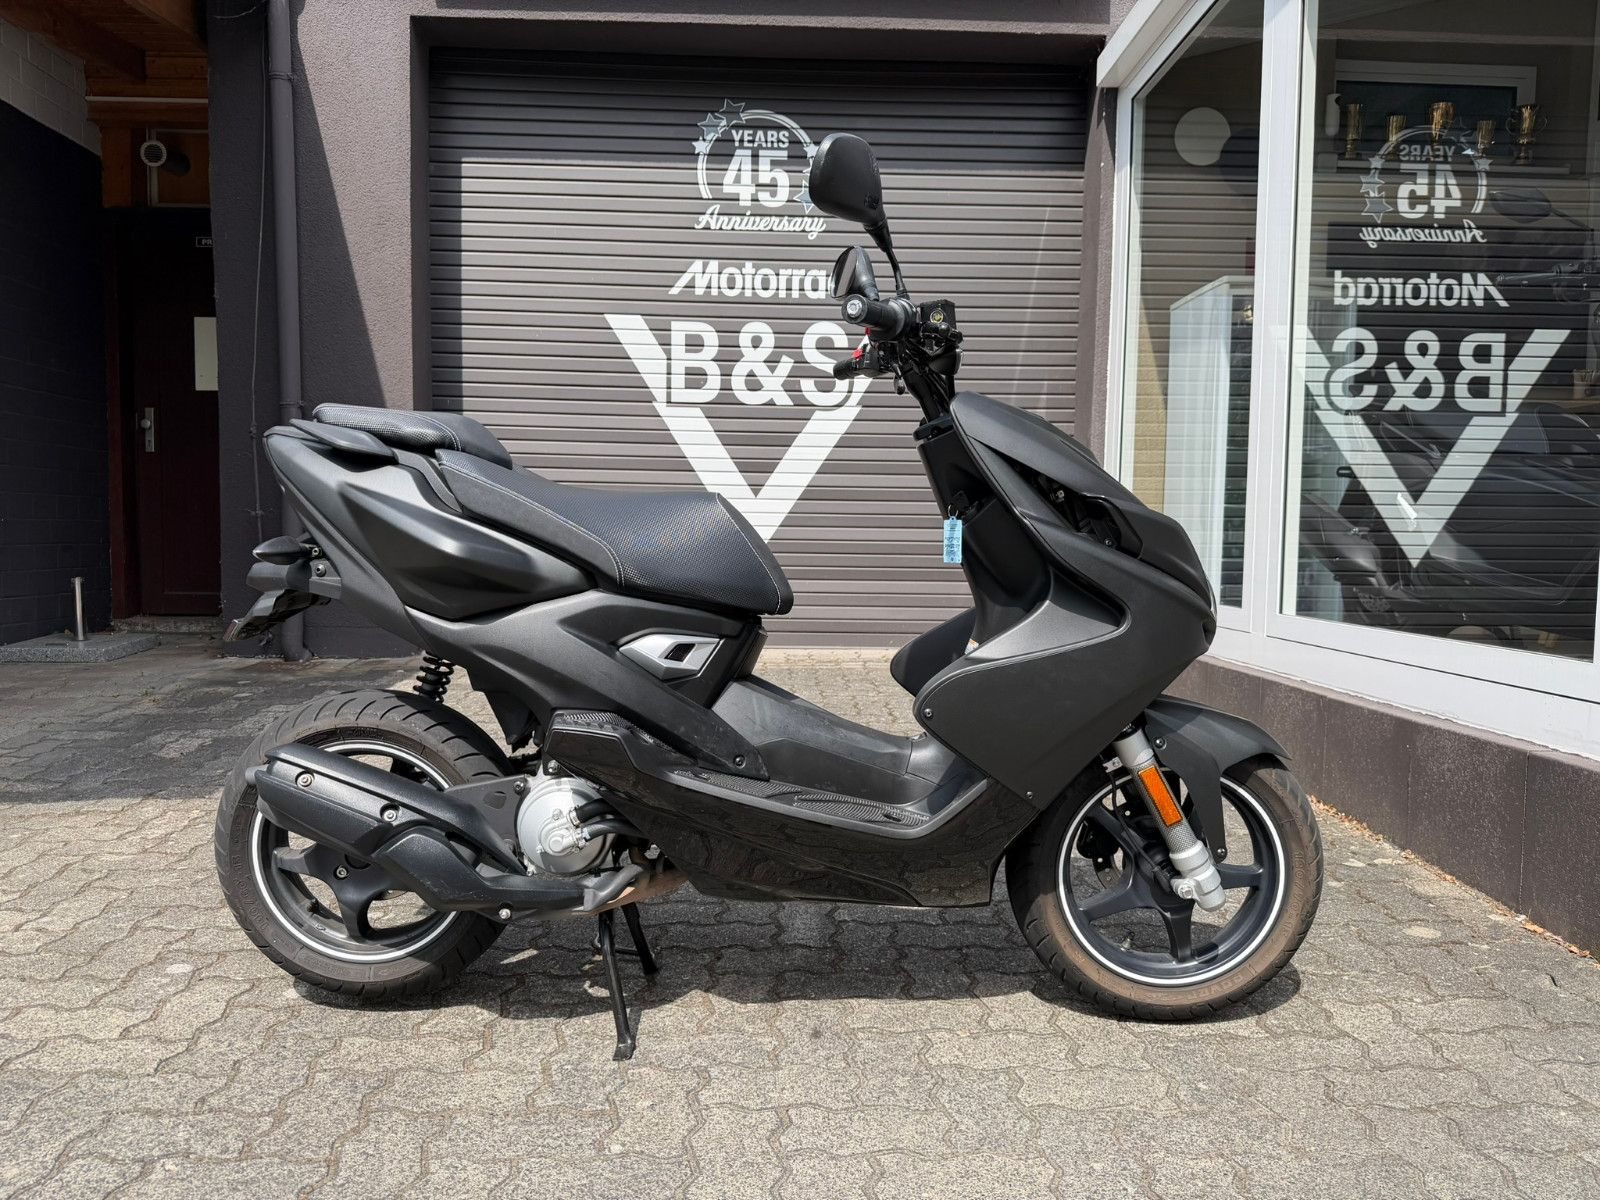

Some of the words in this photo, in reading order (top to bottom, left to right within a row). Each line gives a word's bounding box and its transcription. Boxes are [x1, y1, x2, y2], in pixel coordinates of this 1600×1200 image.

[731, 129, 790, 149] YEARS
[722, 149, 790, 208] 45
[694, 204, 827, 240] Anniversary
[668, 259, 832, 299] Motorra
[670, 320, 849, 406] B&S
